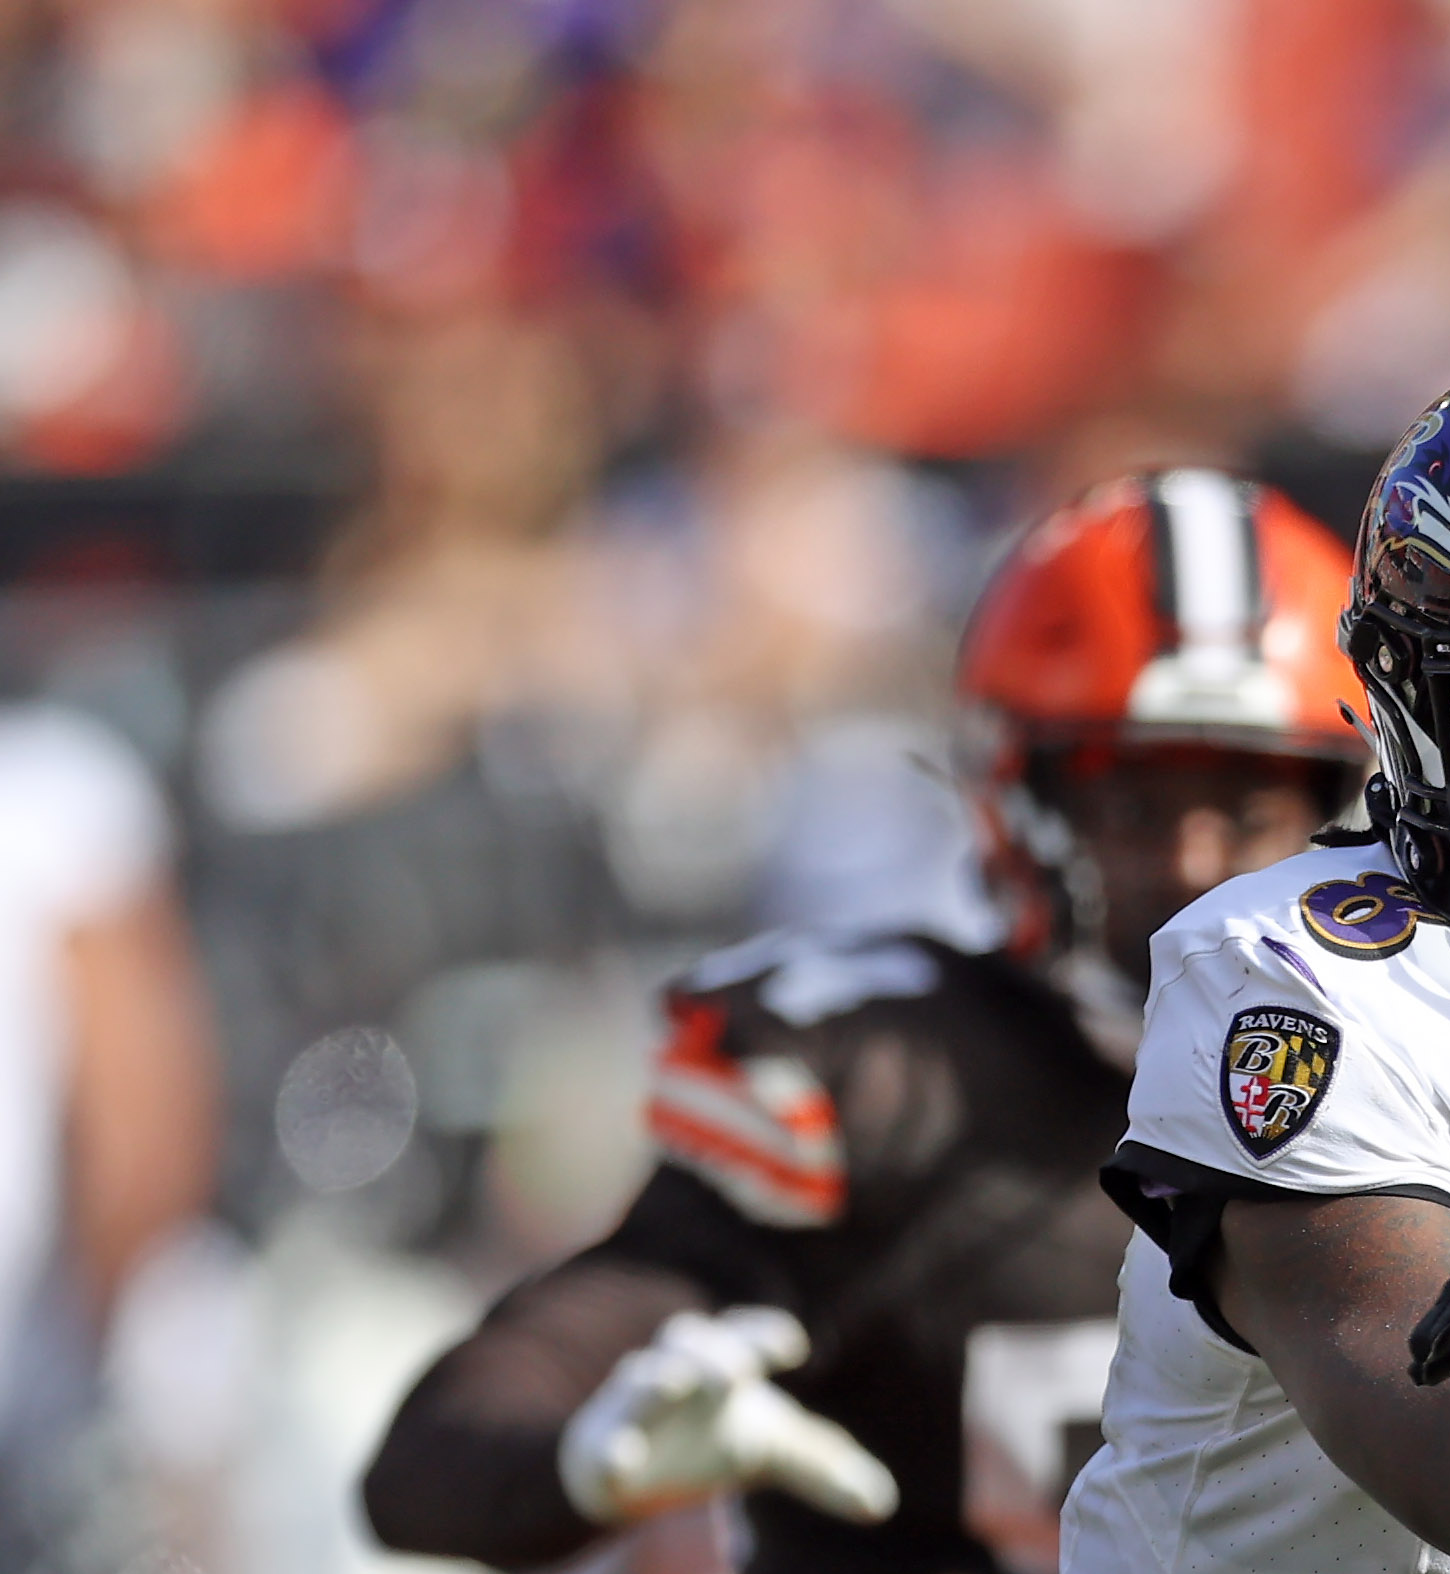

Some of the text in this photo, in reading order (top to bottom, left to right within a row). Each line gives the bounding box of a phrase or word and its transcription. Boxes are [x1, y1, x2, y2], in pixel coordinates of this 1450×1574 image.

[1239, 1013, 1328, 1044] RAVENS
[1233, 1032, 1283, 1074] B
[1261, 1084, 1311, 1129] R
